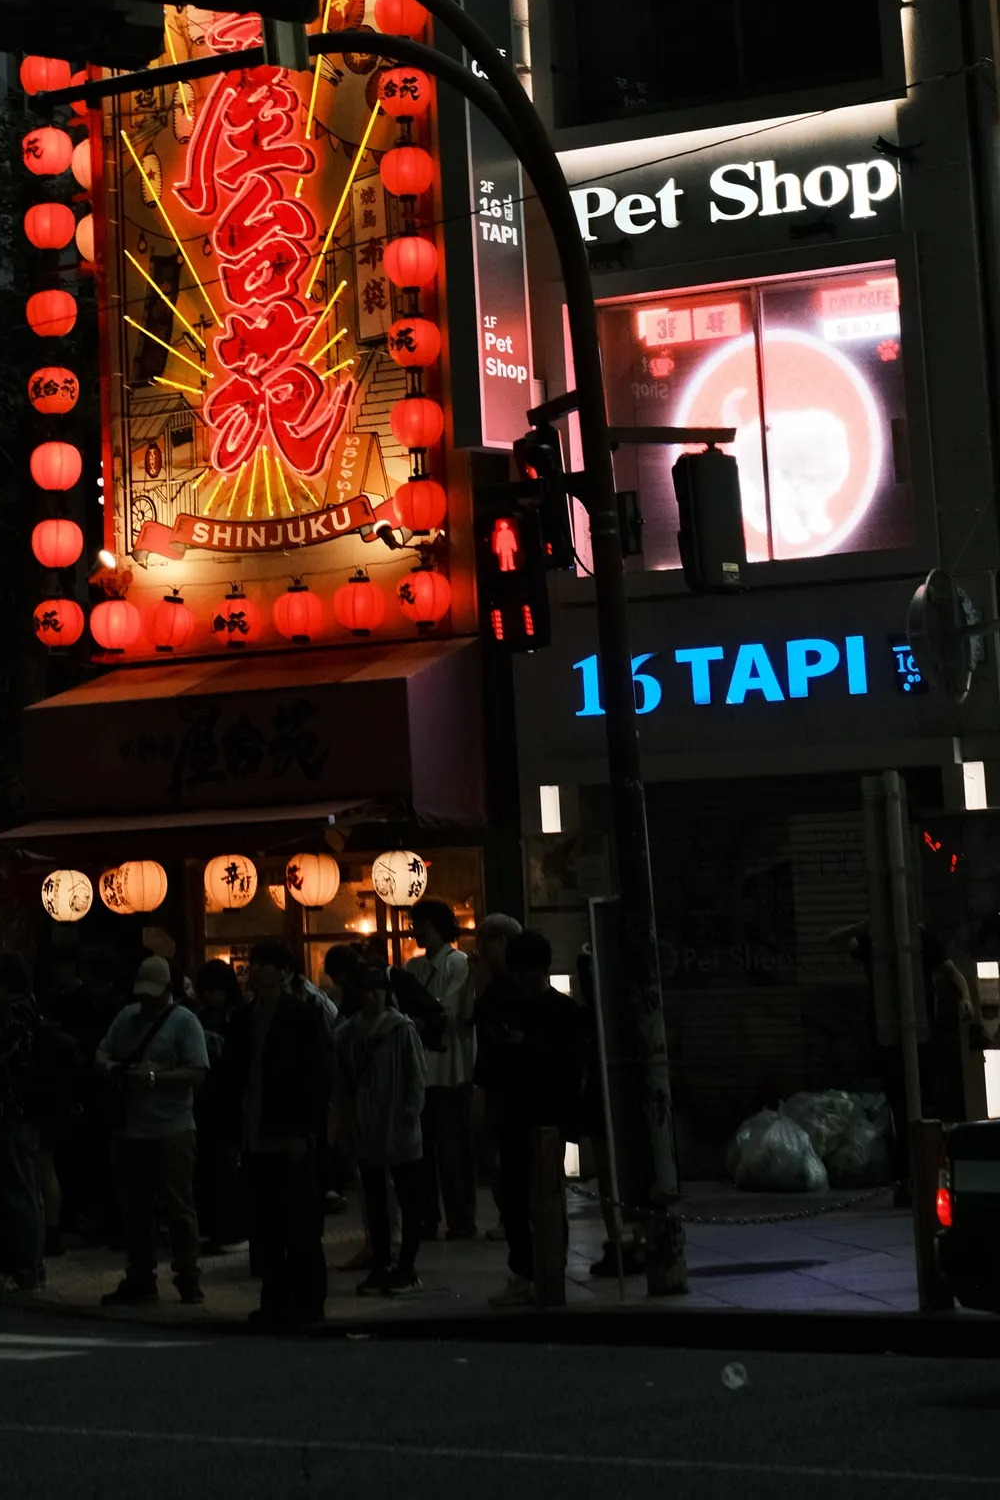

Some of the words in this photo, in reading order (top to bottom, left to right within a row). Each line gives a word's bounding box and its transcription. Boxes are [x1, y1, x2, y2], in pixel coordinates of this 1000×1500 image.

[480, 180, 495, 194] 2F
[479, 197, 502, 218] 16
[571, 177, 684, 242] Pet
[709, 158, 899, 223] Shop
[479, 221, 518, 246] TAPI
[483, 316, 497, 329] 1F
[484, 332, 513, 354] Pet
[485, 357, 528, 383] Shop
[191, 506, 352, 549] SHINJUKU
[675, 635, 868, 705] TAPI
